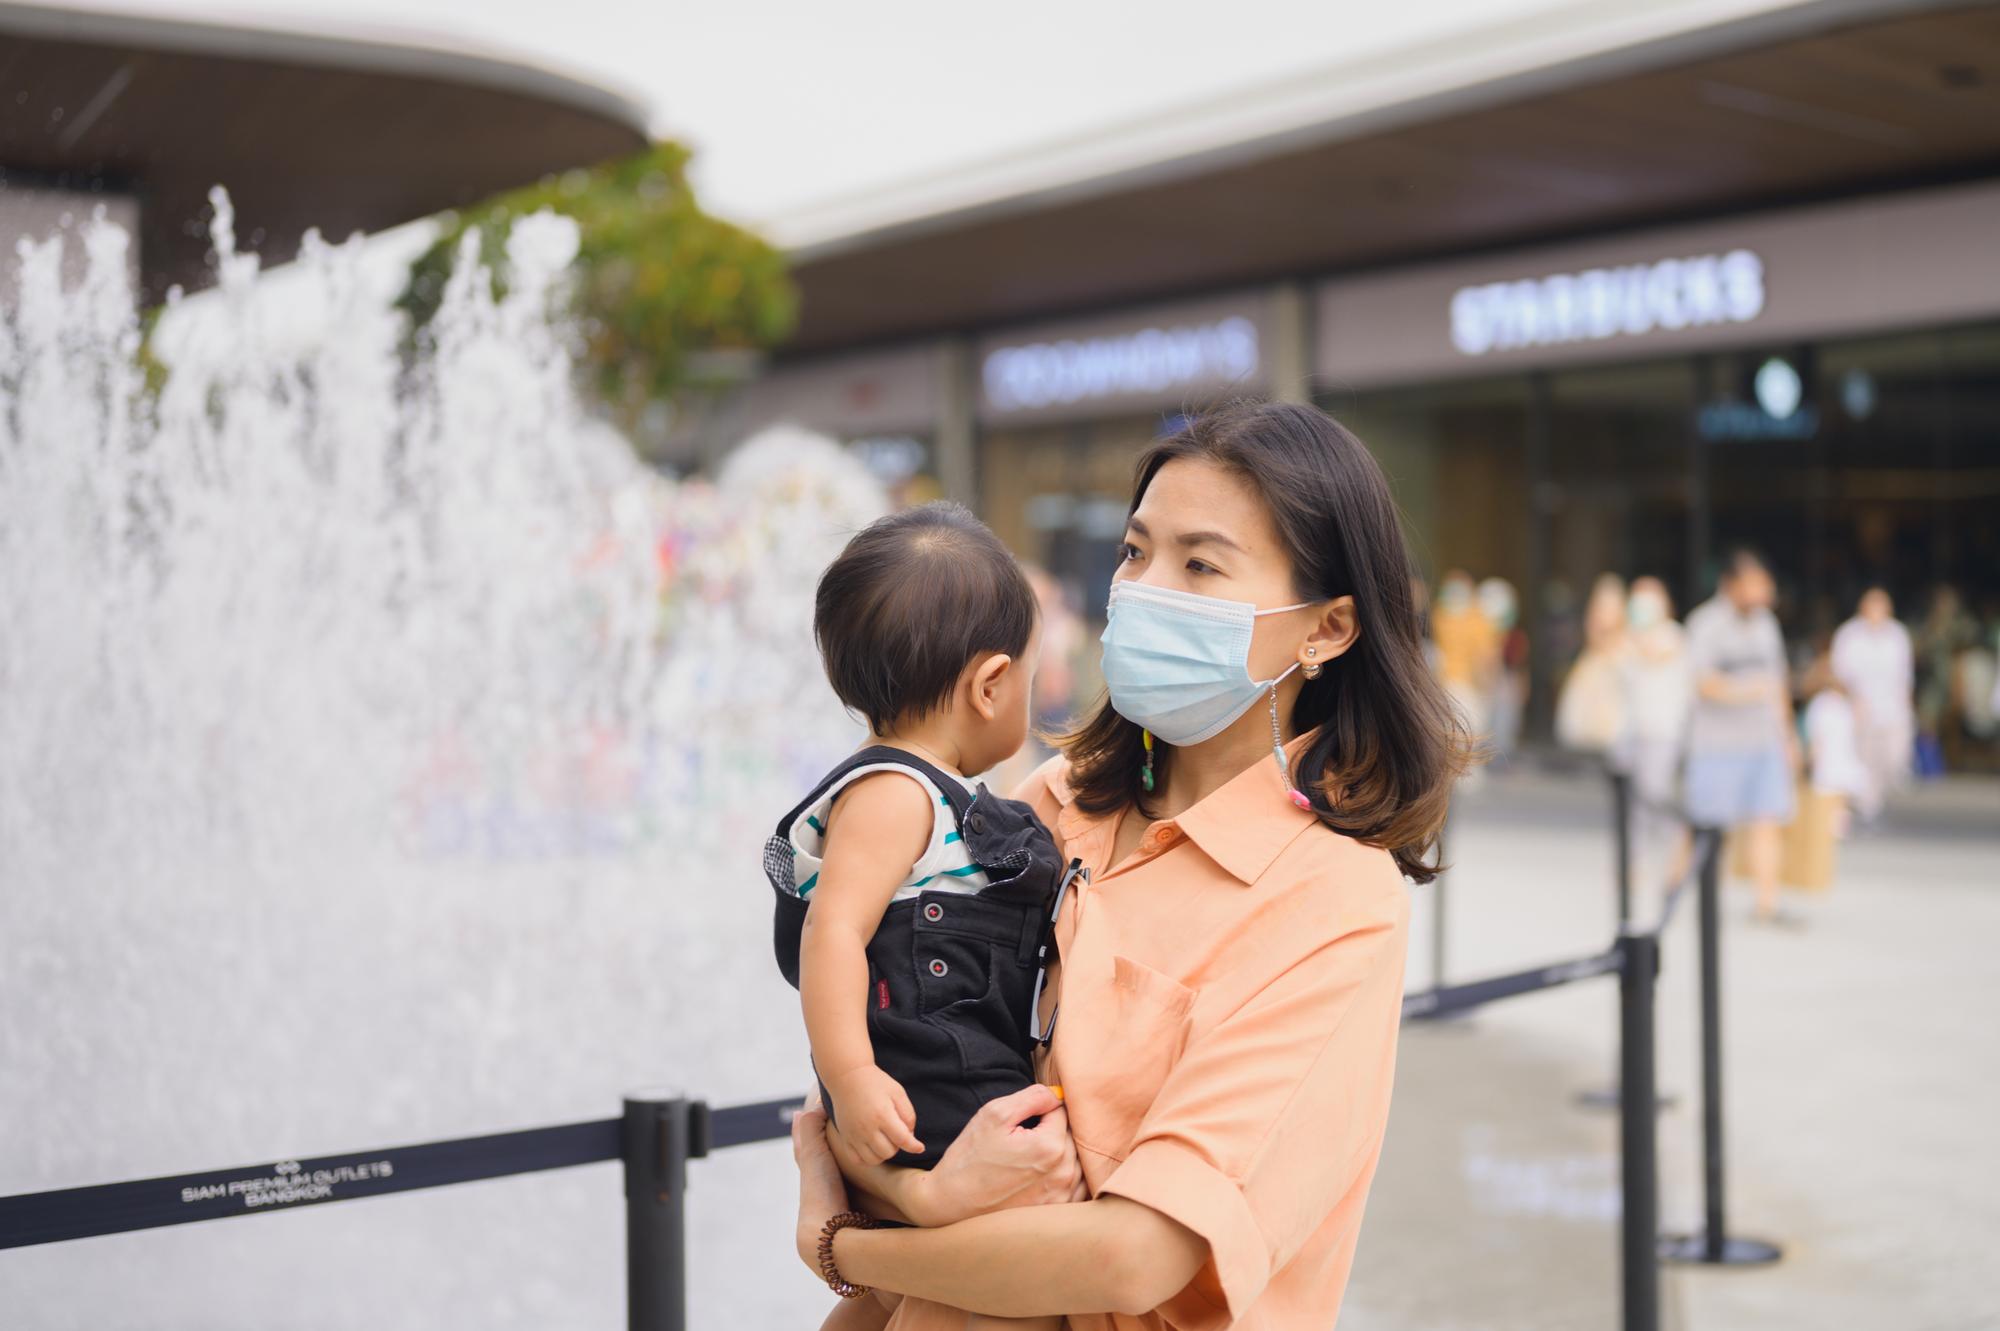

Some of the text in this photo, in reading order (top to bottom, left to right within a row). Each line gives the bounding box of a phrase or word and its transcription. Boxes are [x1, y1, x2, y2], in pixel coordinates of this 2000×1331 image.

[1451, 249, 1764, 355] STARBUCKS
[181, 1160, 393, 1202] SIAM PREMIUM OUTLETS
[245, 1184, 333, 1207] BANGKOK
